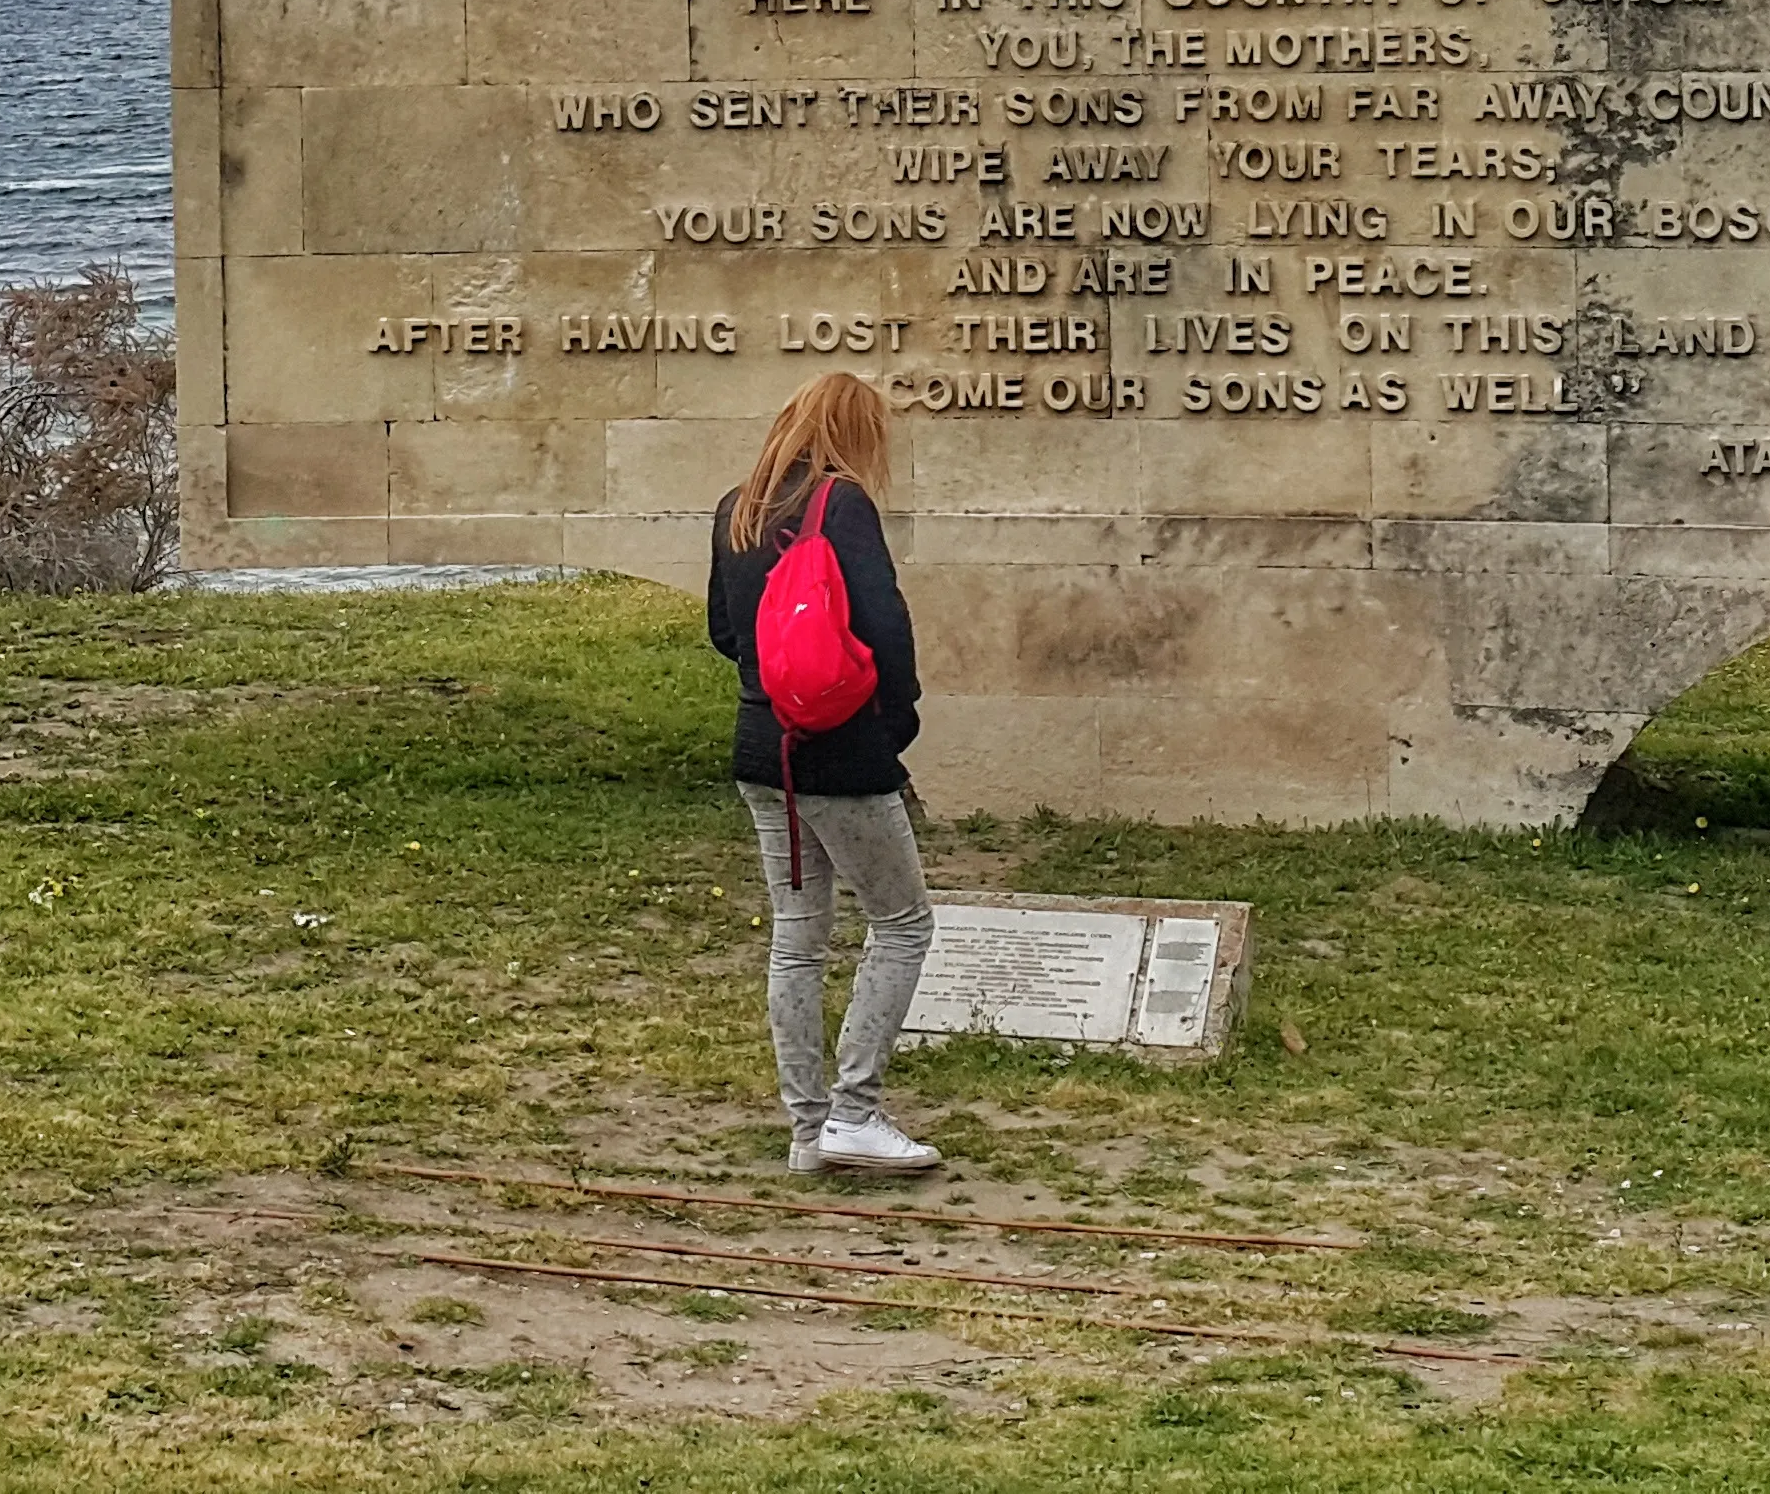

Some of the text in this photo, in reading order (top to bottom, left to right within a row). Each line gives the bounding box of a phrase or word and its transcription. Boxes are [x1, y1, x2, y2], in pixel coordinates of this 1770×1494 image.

[978, 25, 1490, 72] YOU, THE MOTHERS,
[553, 92, 661, 131] WHO
[690, 88, 817, 128] SENT
[837, 86, 981, 126] THEIR
[1005, 84, 1146, 125] SONS
[1175, 83, 1324, 122] FROM
[1347, 82, 1440, 120] FAR
[1475, 79, 1609, 120] AWAY
[889, 138, 1557, 183] WIPE AWAY YOUR TEARS;
[654, 203, 786, 243] YOUR
[812, 201, 947, 241] SONS
[979, 202, 1076, 240] ARE
[1100, 202, 1208, 238] NOW
[1247, 200, 1390, 239] LYING
[1431, 200, 1477, 237] IN
[1504, 199, 1615, 240] OUR
[946, 256, 1489, 296] AND ARE IN PEACE.
[368, 316, 524, 353] AFTER
[560, 313, 737, 354] HAVING
[779, 312, 909, 352] LOST
[954, 313, 1098, 352] THEIR
[1144, 312, 1293, 354] LIVES
[1339, 312, 1412, 352] ON
[1443, 314, 1565, 355] THIS
[1611, 314, 1759, 357] LAND
[855, 371, 1024, 411] COME
[1043, 371, 1147, 410] OUR
[1182, 370, 1323, 412] SONS
[1340, 372, 1407, 411] AS
[1439, 372, 1579, 412] WELL
